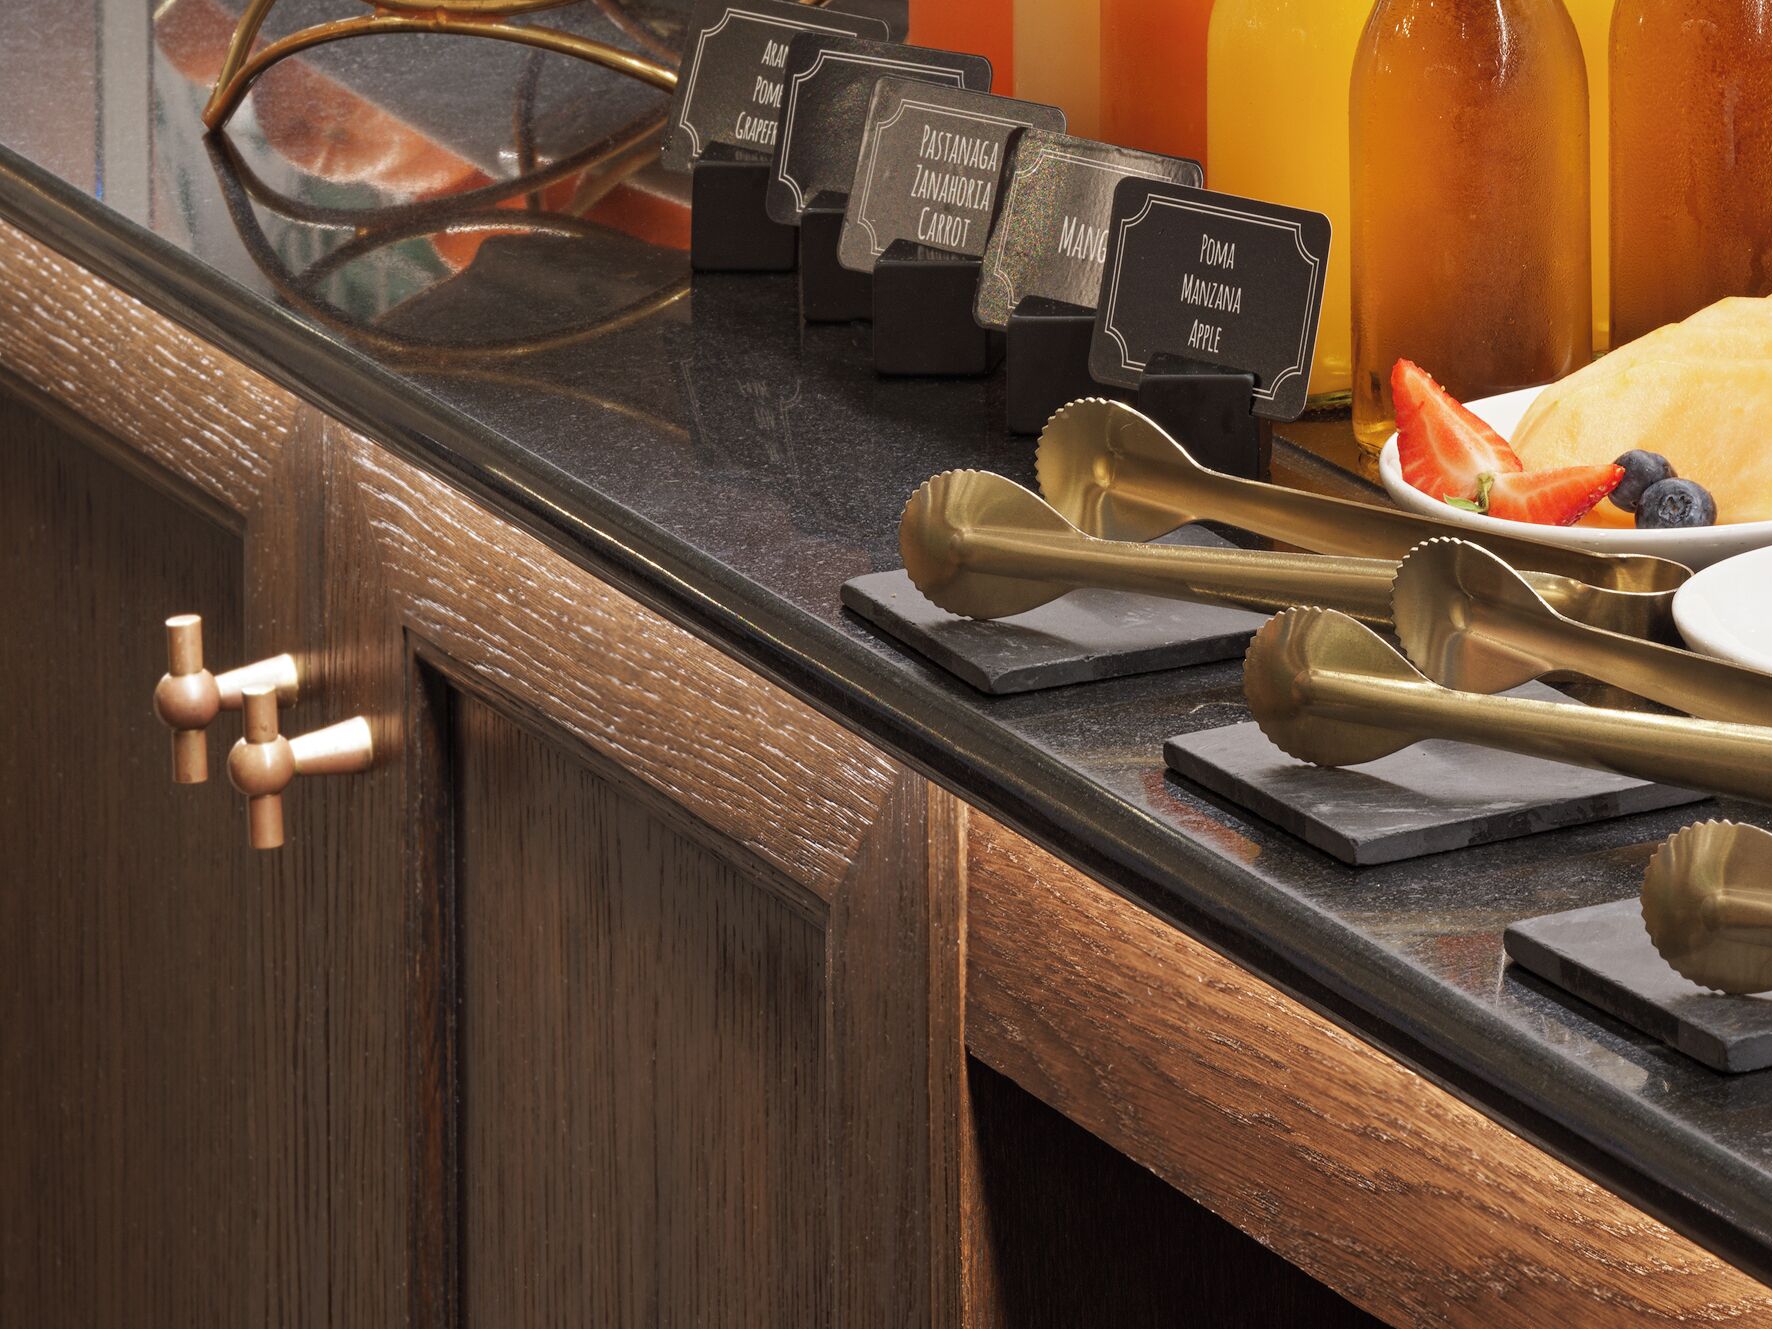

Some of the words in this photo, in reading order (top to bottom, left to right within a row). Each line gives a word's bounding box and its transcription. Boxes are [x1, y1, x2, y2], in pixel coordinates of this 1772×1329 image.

[920, 124, 999, 172] PASTANAGA
[911, 164, 991, 212] ZANAHORIA
[917, 207, 970, 248] CARROT
[1058, 215, 1109, 264] MANG
[1200, 233, 1235, 269] POMA
[1181, 273, 1241, 314] MANZANA
[1187, 319, 1222, 353] APPLE
